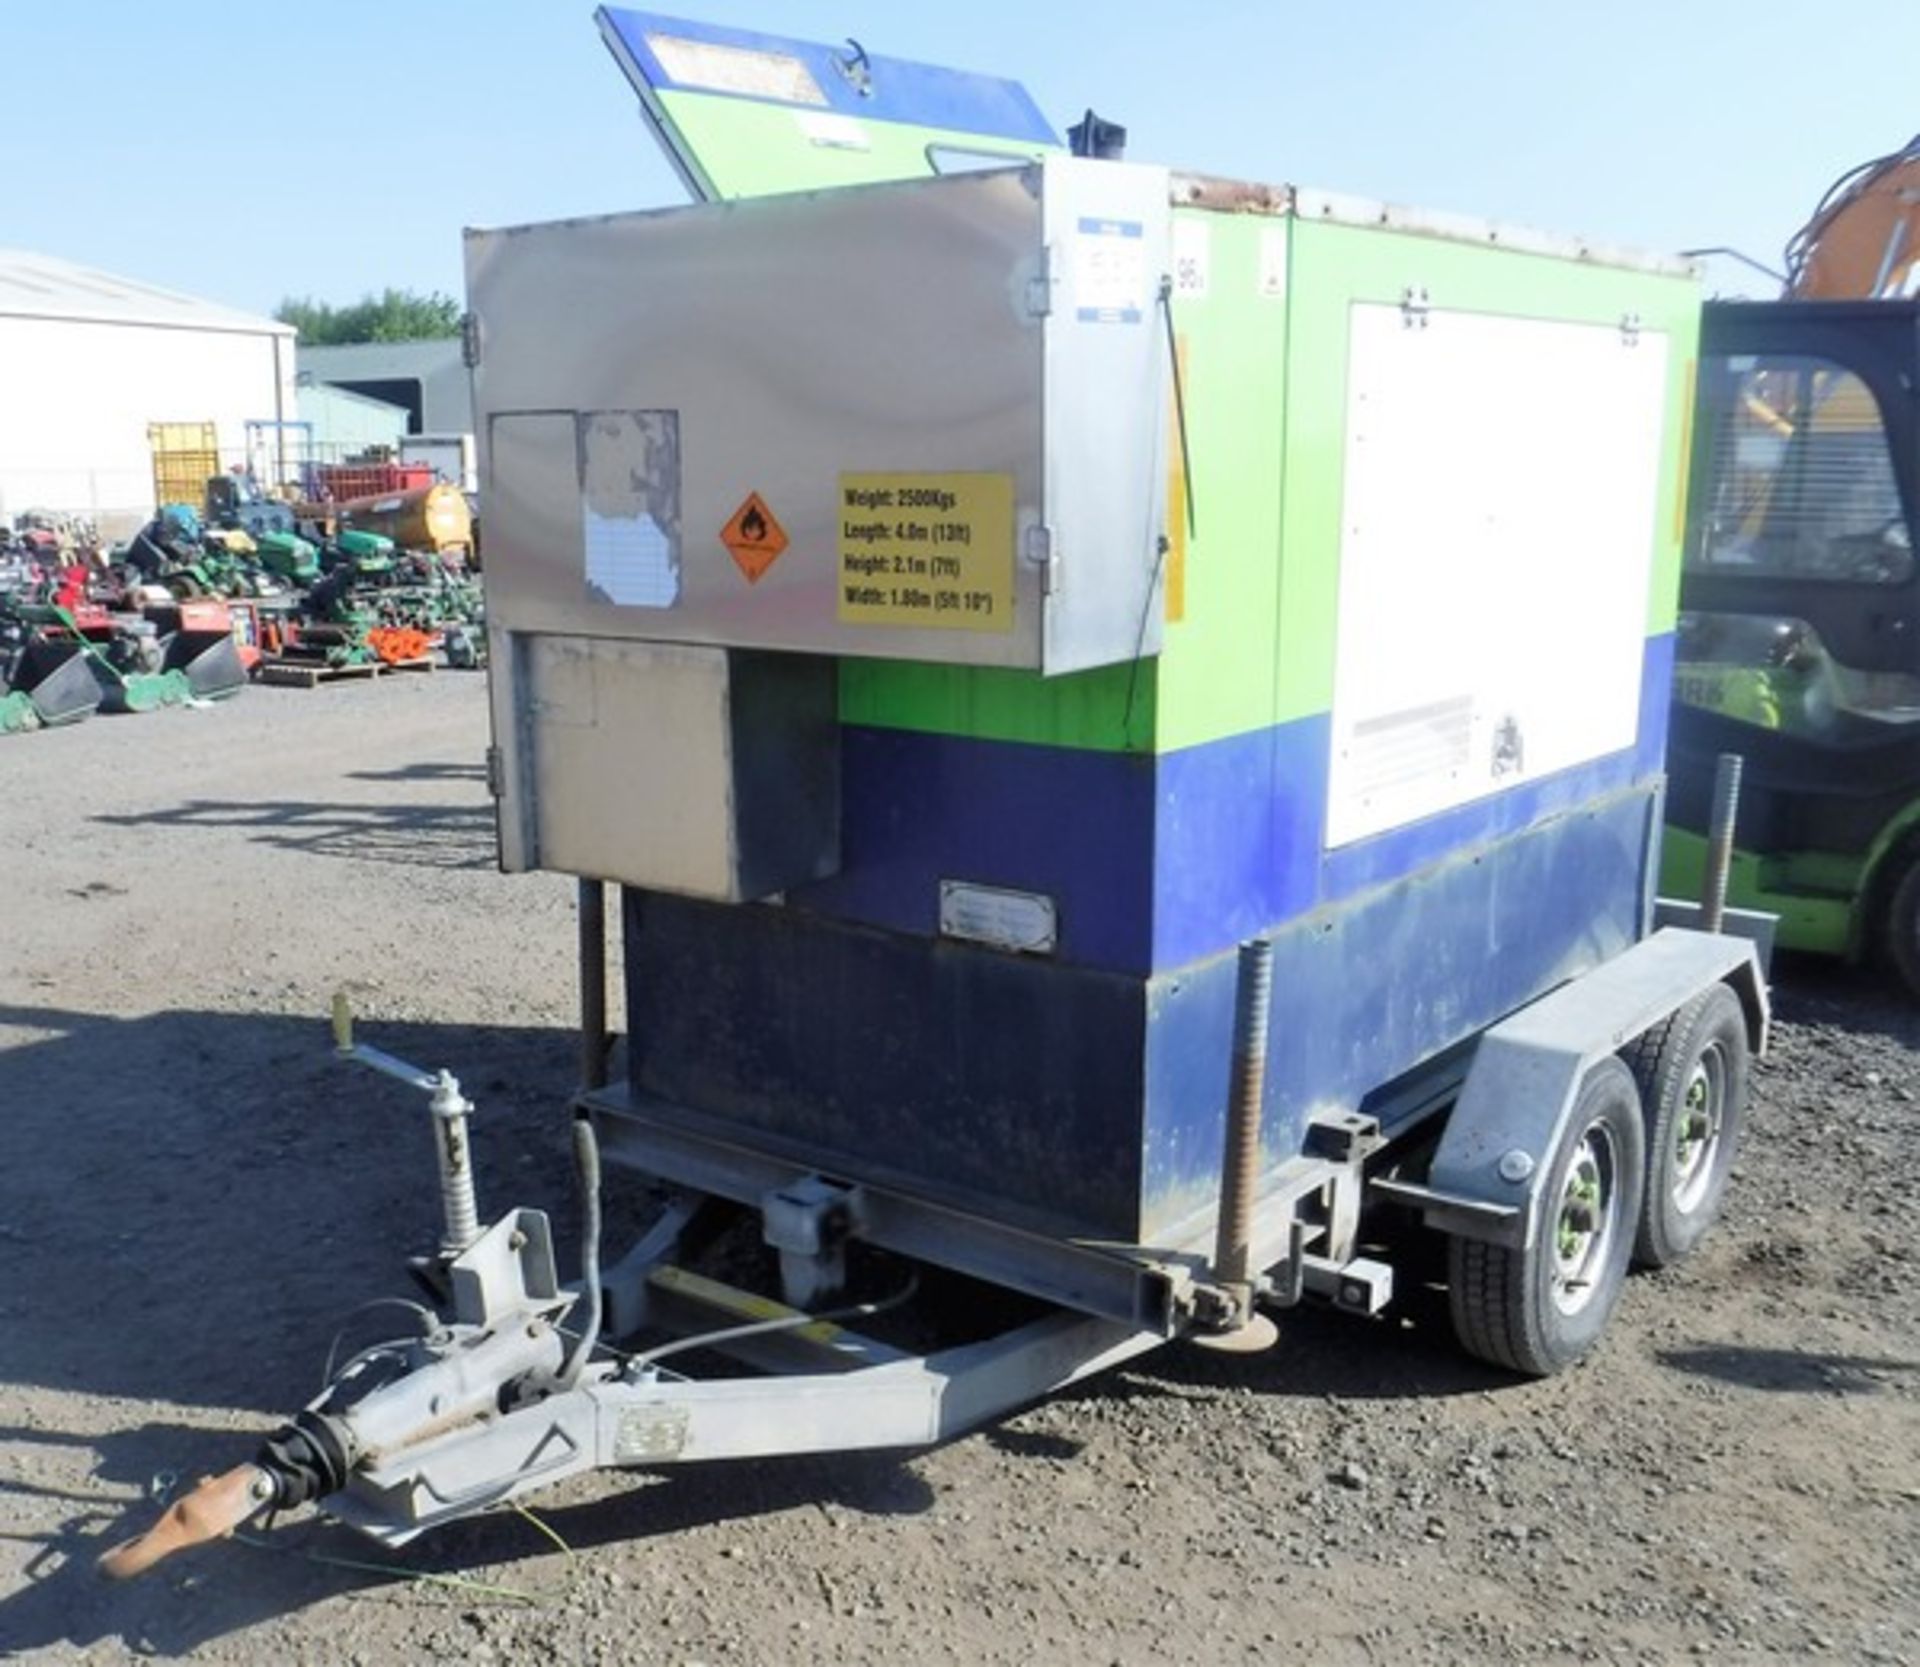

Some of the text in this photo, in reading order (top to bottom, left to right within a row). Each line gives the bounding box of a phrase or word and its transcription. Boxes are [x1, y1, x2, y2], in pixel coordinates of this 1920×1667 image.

[844, 489, 956, 511] Weight: 2500Kgs
[844, 521, 971, 545] Length: 4.0m (13ft)
[844, 554, 960, 579] Height: 2.1m (7ft)
[845, 586, 886, 605] Width:
[935, 591, 960, 612] (5ft
